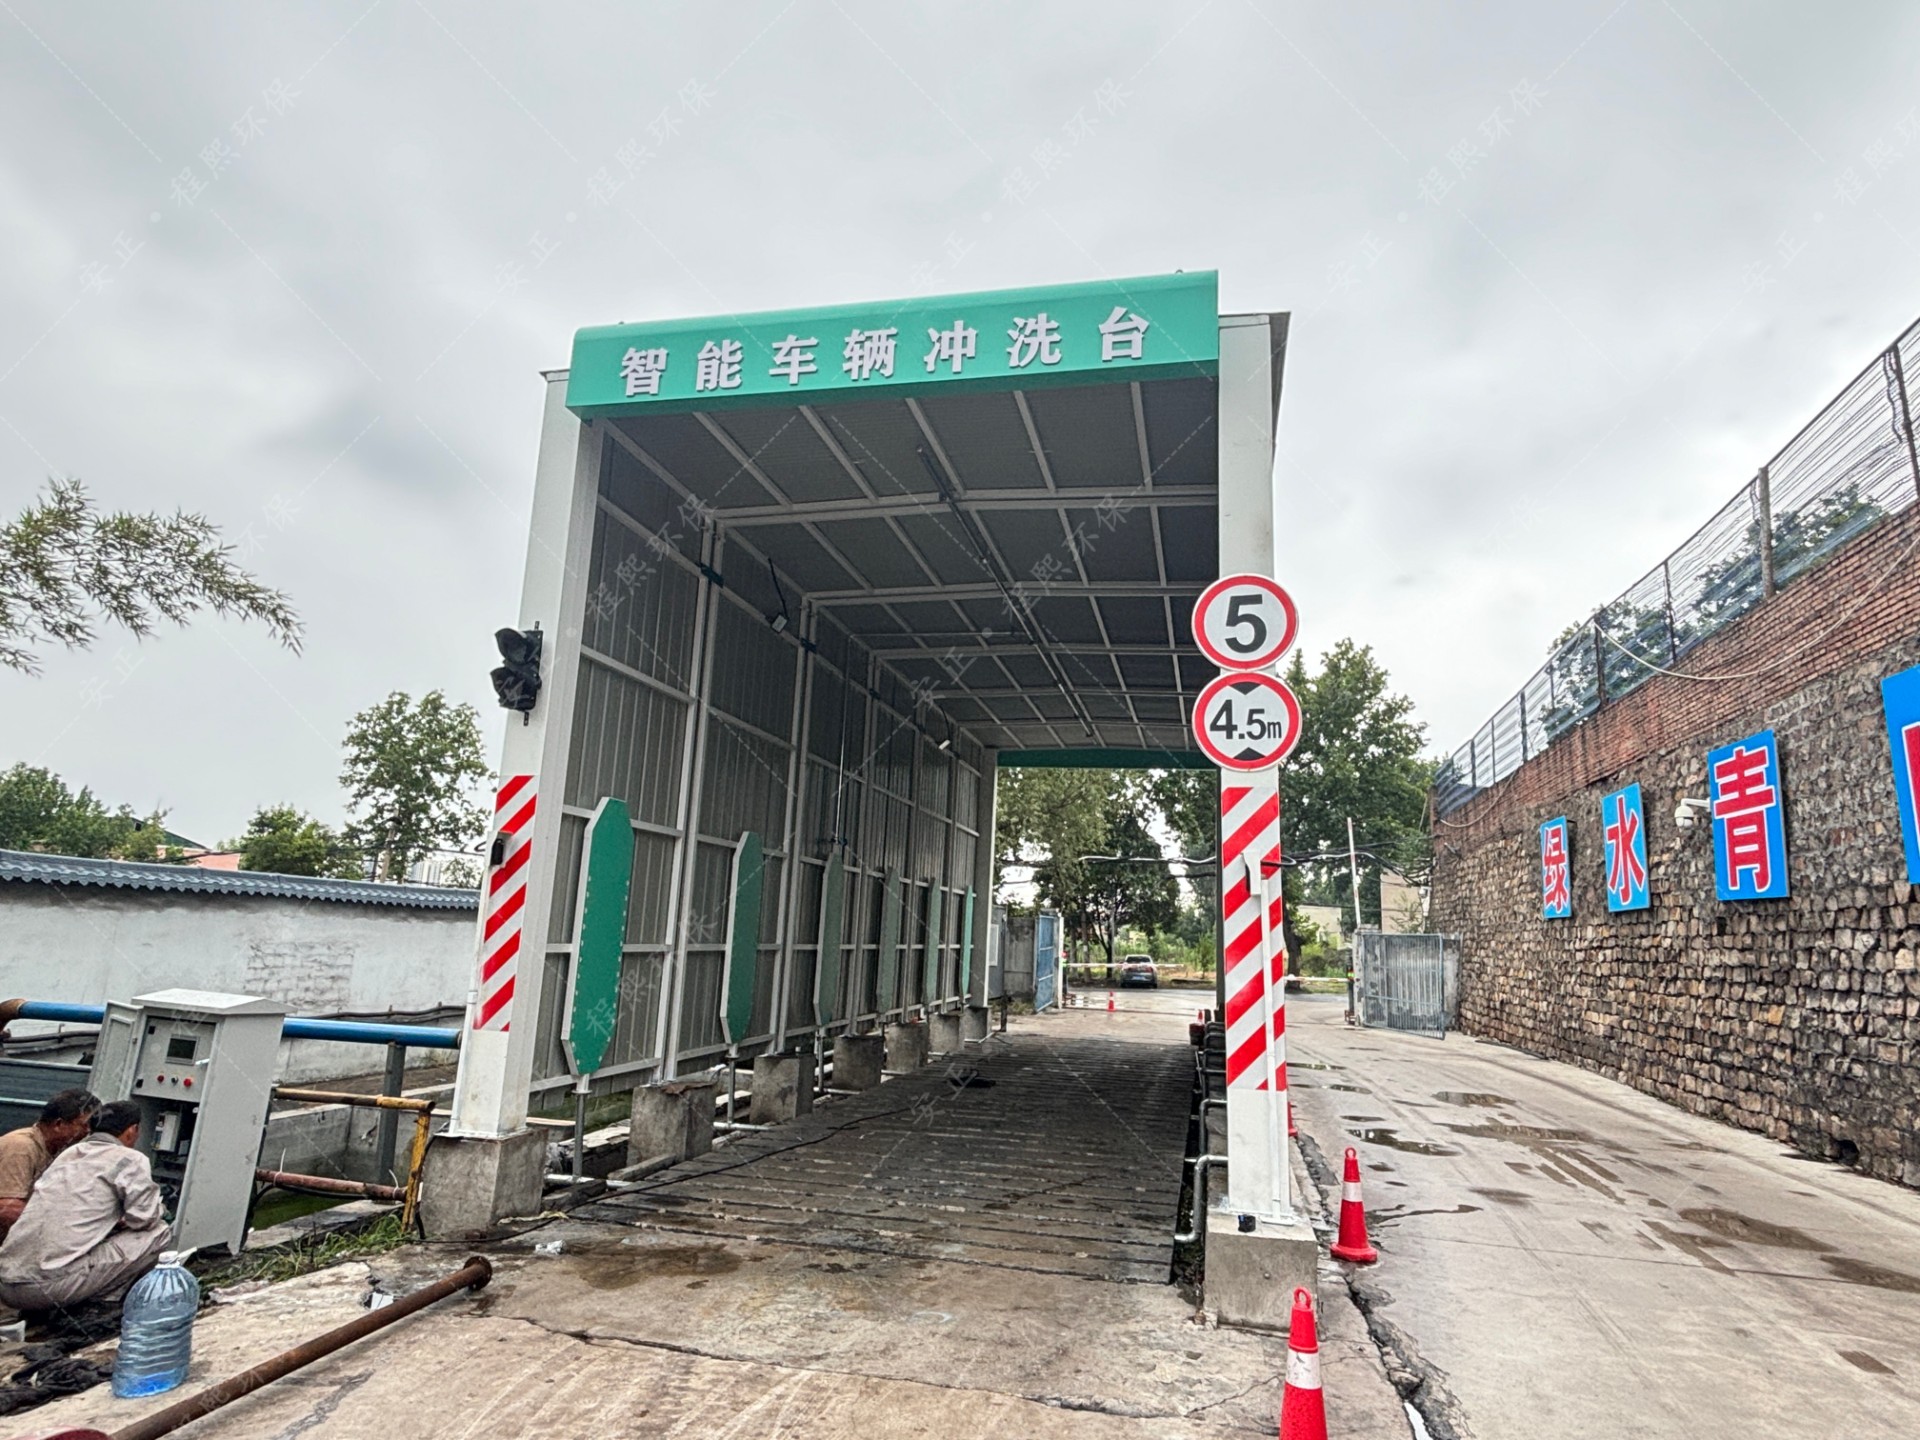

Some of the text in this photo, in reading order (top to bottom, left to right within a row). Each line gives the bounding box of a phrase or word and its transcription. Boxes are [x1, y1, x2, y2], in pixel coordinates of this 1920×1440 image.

[619, 305, 1151, 397] 智能车辆冲洗台
[1225, 594, 1267, 653] 5
[1210, 699, 1282, 740] 4.5m
